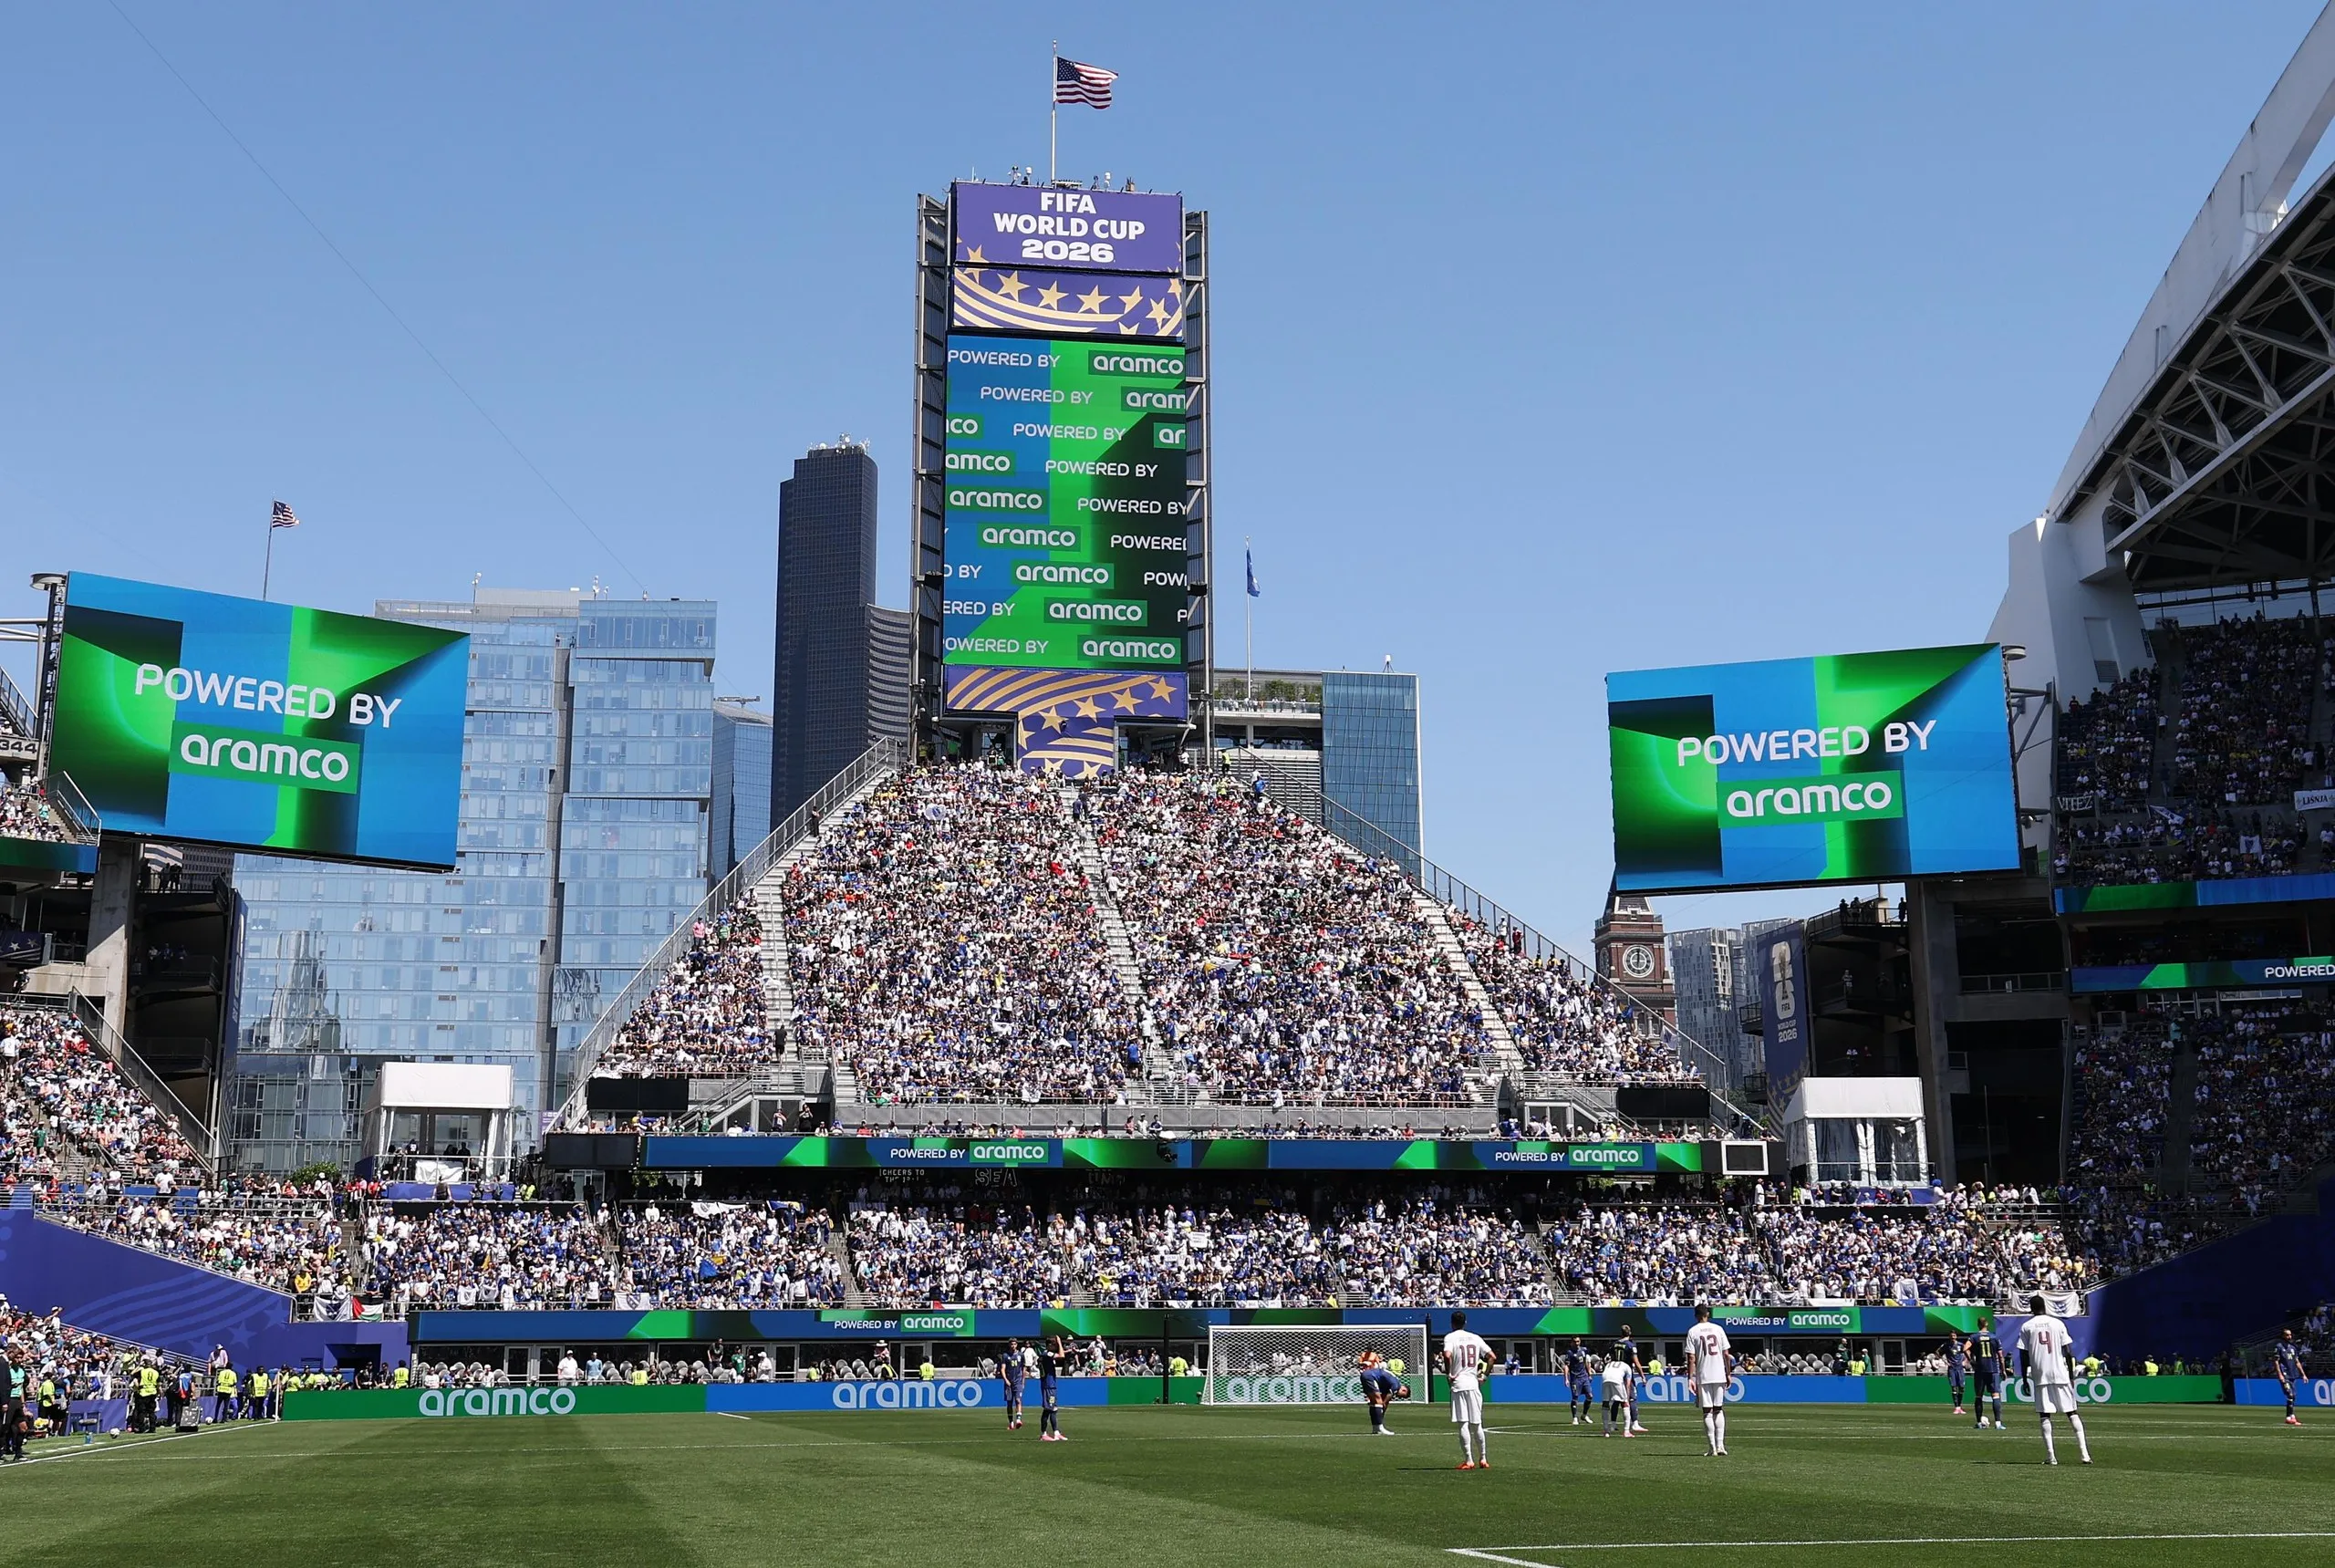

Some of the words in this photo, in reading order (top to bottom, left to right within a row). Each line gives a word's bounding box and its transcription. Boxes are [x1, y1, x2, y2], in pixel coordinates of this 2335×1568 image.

[1041, 192, 1096, 214] FIFA
[993, 213, 1088, 238] WORLD
[1093, 219, 1145, 240] CUP
[1021, 239, 1115, 263] 2026
[948, 349, 1033, 367] POWERED
[1037, 355, 1061, 368] BY
[1093, 355, 1184, 375] aramco
[981, 387, 1065, 403] POWERED
[1070, 390, 1094, 404] BY
[1012, 423, 1097, 440] POWERED
[1103, 428, 1126, 441] BY
[1158, 429, 1186, 444] ar
[1045, 461, 1130, 476] POWERED
[1136, 464, 1158, 478] BY
[949, 490, 1043, 510] aramco
[1077, 497, 1161, 514] POWERED
[1168, 502, 1188, 515] BY
[982, 527, 1076, 547] aramco
[959, 566, 982, 579] BY
[1015, 565, 1110, 585] aramco
[1144, 572, 1187, 587] POW
[991, 603, 1016, 617] BY
[1049, 602, 1143, 622] aramco
[943, 638, 1020, 653] OWERED
[1026, 640, 1049, 654] BY
[1083, 639, 1177, 659] aramco
[135, 662, 337, 721] POWERED
[348, 691, 402, 729] BY
[0, 739, 37, 754] 344
[1676, 724, 1871, 768] POWERED
[1884, 719, 1937, 755] BY
[181, 732, 349, 782] aramco
[1726, 781, 1893, 819] aramco
[2265, 964, 2335, 979] POWERED
[1778, 1027, 1798, 1044] 2026
[890, 1148, 946, 1159] POWERED
[950, 1148, 966, 1159] BY
[972, 1144, 1045, 1159] aramco
[1495, 1151, 1548, 1162] POWERED
[1551, 1152, 1565, 1162] BY
[1572, 1148, 1640, 1163] aramco
[834, 1320, 881, 1330] POWERED
[885, 1320, 898, 1330] BY
[903, 1315, 964, 1330] aramco
[1725, 1317, 1770, 1326] POWERED
[1773, 1317, 1786, 1326] BY
[1791, 1314, 1850, 1326] aramco
[1699, 1334, 1718, 1357] 12
[1980, 1342, 1992, 1358] 11
[2038, 1331, 2052, 1355] 4
[1459, 1345, 1477, 1368] 18
[418, 1387, 576, 1417] aramco
[832, 1380, 982, 1409] aramco
